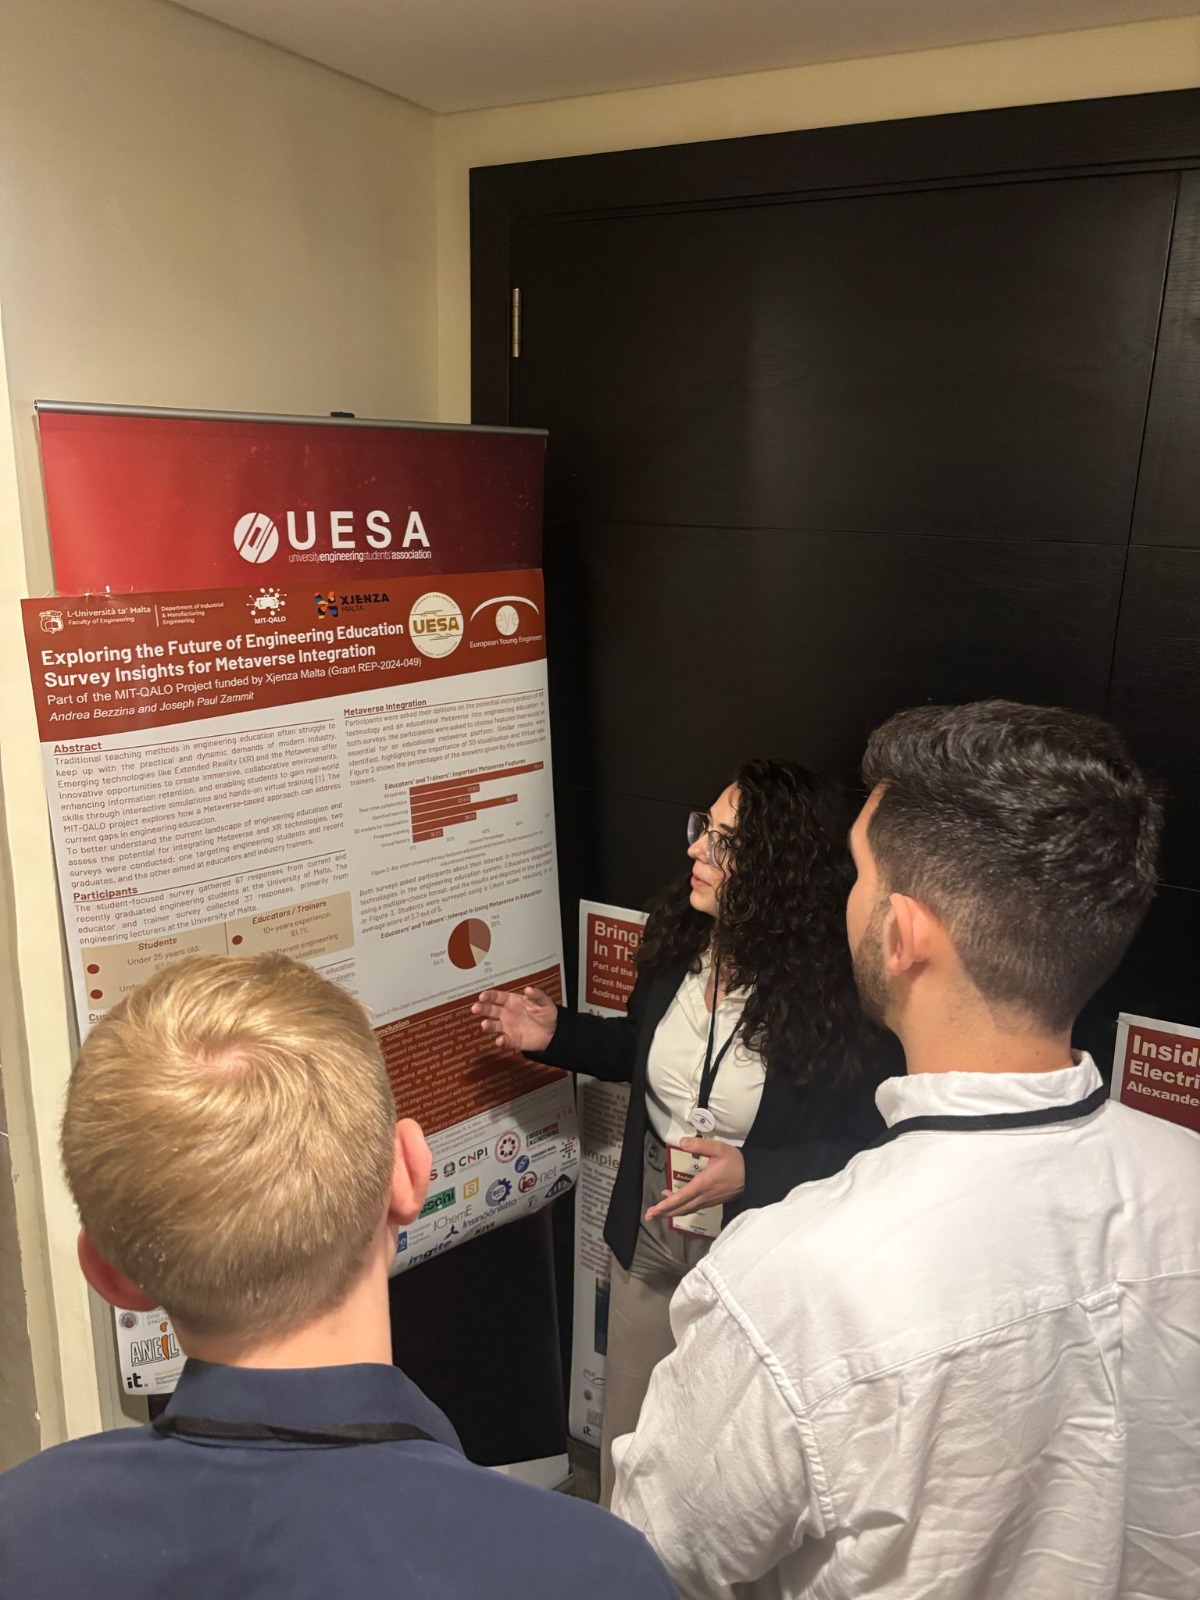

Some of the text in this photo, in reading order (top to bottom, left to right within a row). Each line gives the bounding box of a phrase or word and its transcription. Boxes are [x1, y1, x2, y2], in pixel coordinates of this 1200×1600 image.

[286, 510, 430, 550] UESA
[340, 593, 389, 604] XJENZA
[67, 608, 115, 617] L-Università
[255, 616, 286, 624] MIT-QALO
[413, 617, 460, 634] UESA
[42, 622, 403, 667] Exploring the Future of Engineering Education
[470, 640, 498, 648] European
[45, 644, 376, 687] Survey Insights for Metaverse Integration
[48, 657, 421, 705] Part of the MIT-QALO Project funded by Xjenza Malta (Grant REP-2024-049)
[50, 691, 254, 721] Andrea Bezzina and Joseph Paul Zammit
[344, 700, 426, 715] Metaverse Integration
[54, 741, 102, 753] Abstract
[55, 755, 101, 765] Traditional
[106, 752, 141, 761] teaching
[146, 746, 179, 756] methods
[194, 739, 236, 749] engineering
[240, 733, 274, 742] education
[299, 724, 325, 733] struggle
[140, 757, 174, 769] practical
[197, 750, 227, 760] dynamic
[232, 744, 263, 754] demands
[279, 738, 305, 746] modern
[58, 779, 99, 787] Emerging
[103, 772, 155, 783] technologies
[175, 763, 210, 774] Extended
[213, 759, 237, 768] Reality
[239, 755, 254, 765] (XR)
[256, 753, 269, 761] and
[285, 747, 319, 756] Metaverse
[416, 775, 425, 783] and
[453, 765, 477, 776] Important
[479, 762, 504, 771] Metaverse
[505, 758, 526, 766] Features
[97, 894, 164, 909] student-focused
[169, 889, 194, 898] survey
[199, 879, 231, 893] gathered
[248, 870, 283, 881] responses
[287, 865, 304, 873] from
[308, 857, 331, 868] current
[335, 853, 347, 861] and
[73, 887, 138, 900] Participants
[252, 911, 290, 924] Educators
[297, 901, 326, 913] Trainers
[411, 922, 421, 930] and
[448, 908, 468, 920] Interest
[489, 898, 514, 909] Metaverse
[520, 890, 542, 900] Education
[276, 923, 293, 932] years
[138, 938, 177, 950] Students
[594, 940, 608, 956] In
[128, 957, 151, 965] Under
[165, 950, 186, 960] years
[593, 961, 633, 976] Part of the
[592, 975, 614, 986] Grant
[592, 988, 620, 1001] Andrea
[375, 1020, 409, 1037] onclusion
[1133, 1034, 1200, 1067] Insid
[459, 1147, 488, 1166] CNPI
